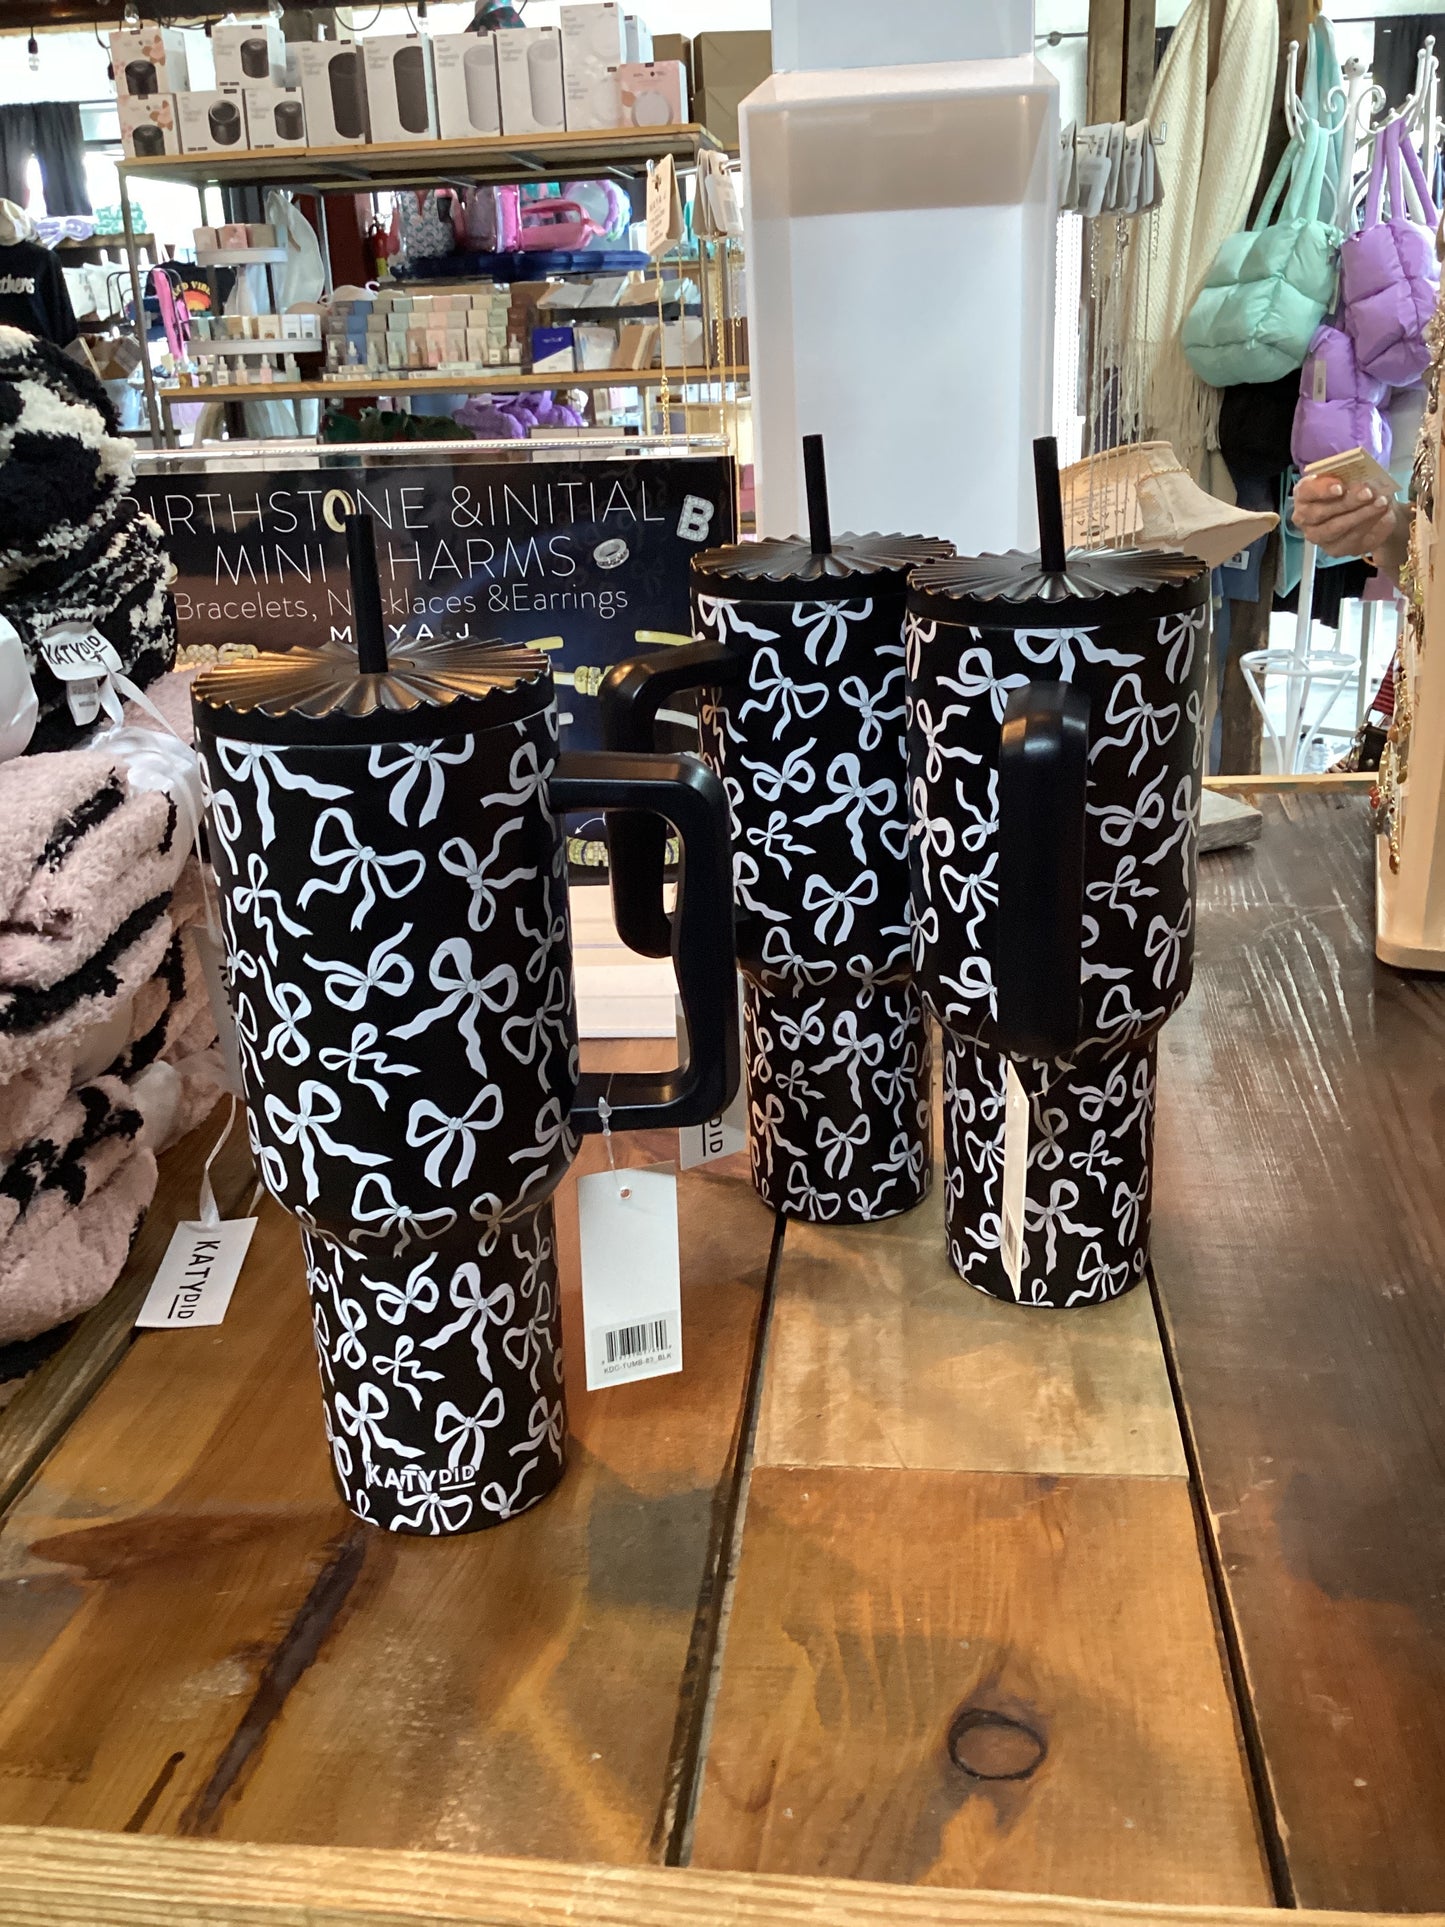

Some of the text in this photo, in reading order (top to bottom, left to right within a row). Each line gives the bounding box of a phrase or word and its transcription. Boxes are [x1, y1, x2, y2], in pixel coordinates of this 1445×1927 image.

[451, 480, 665, 528] &INITIAL
[215, 536, 576, 586] MINI HARMS
[174, 583, 628, 622] Bracelets, Nklaces &Earrings
[42, 635, 101, 665] KATYDID
[330, 623, 434, 643] MYA
[177, 1240, 221, 1319] KATYDID
[366, 1461, 476, 1492] KATYDID
